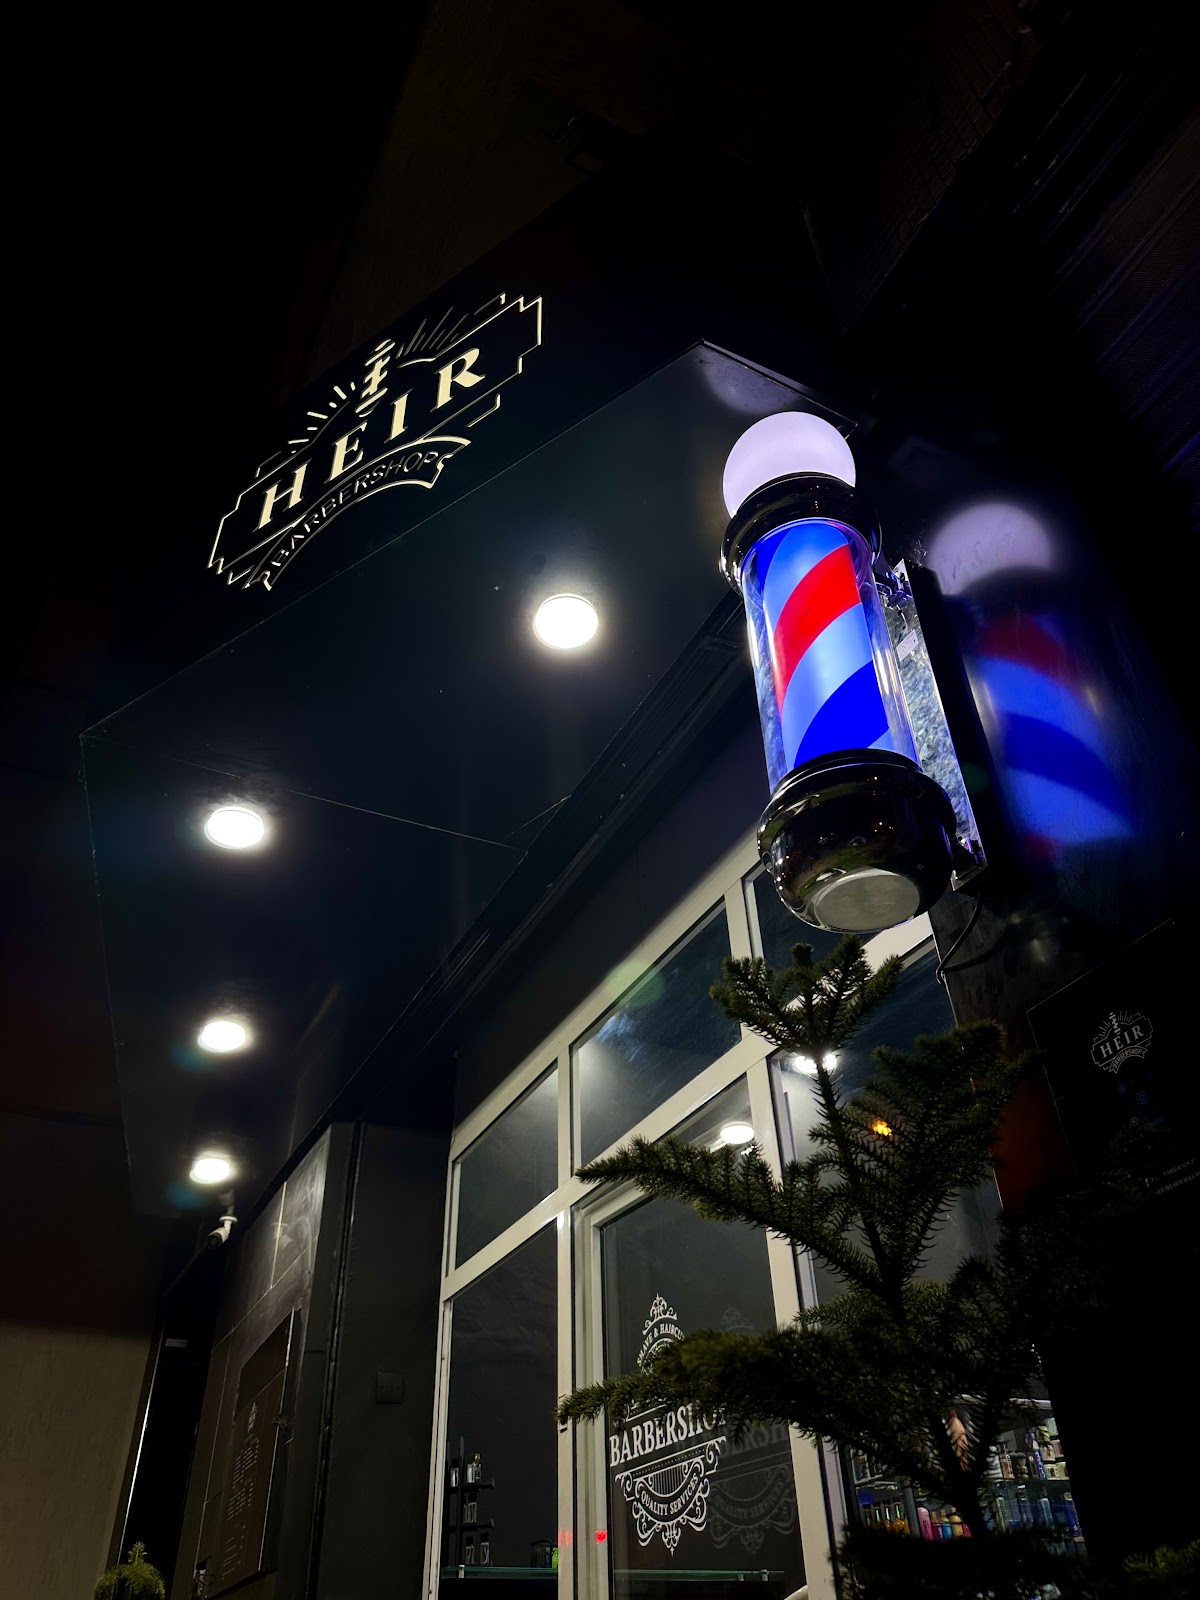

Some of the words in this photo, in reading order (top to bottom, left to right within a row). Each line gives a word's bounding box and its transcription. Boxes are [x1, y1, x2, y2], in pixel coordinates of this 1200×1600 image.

[253, 348, 486, 533] HEIR
[271, 451, 439, 567] BARBERSHOP
[1100, 1025, 1144, 1058] HEIR
[641, 1490, 669, 1515] QUALITY
[670, 1473, 698, 1515] SERVICES
